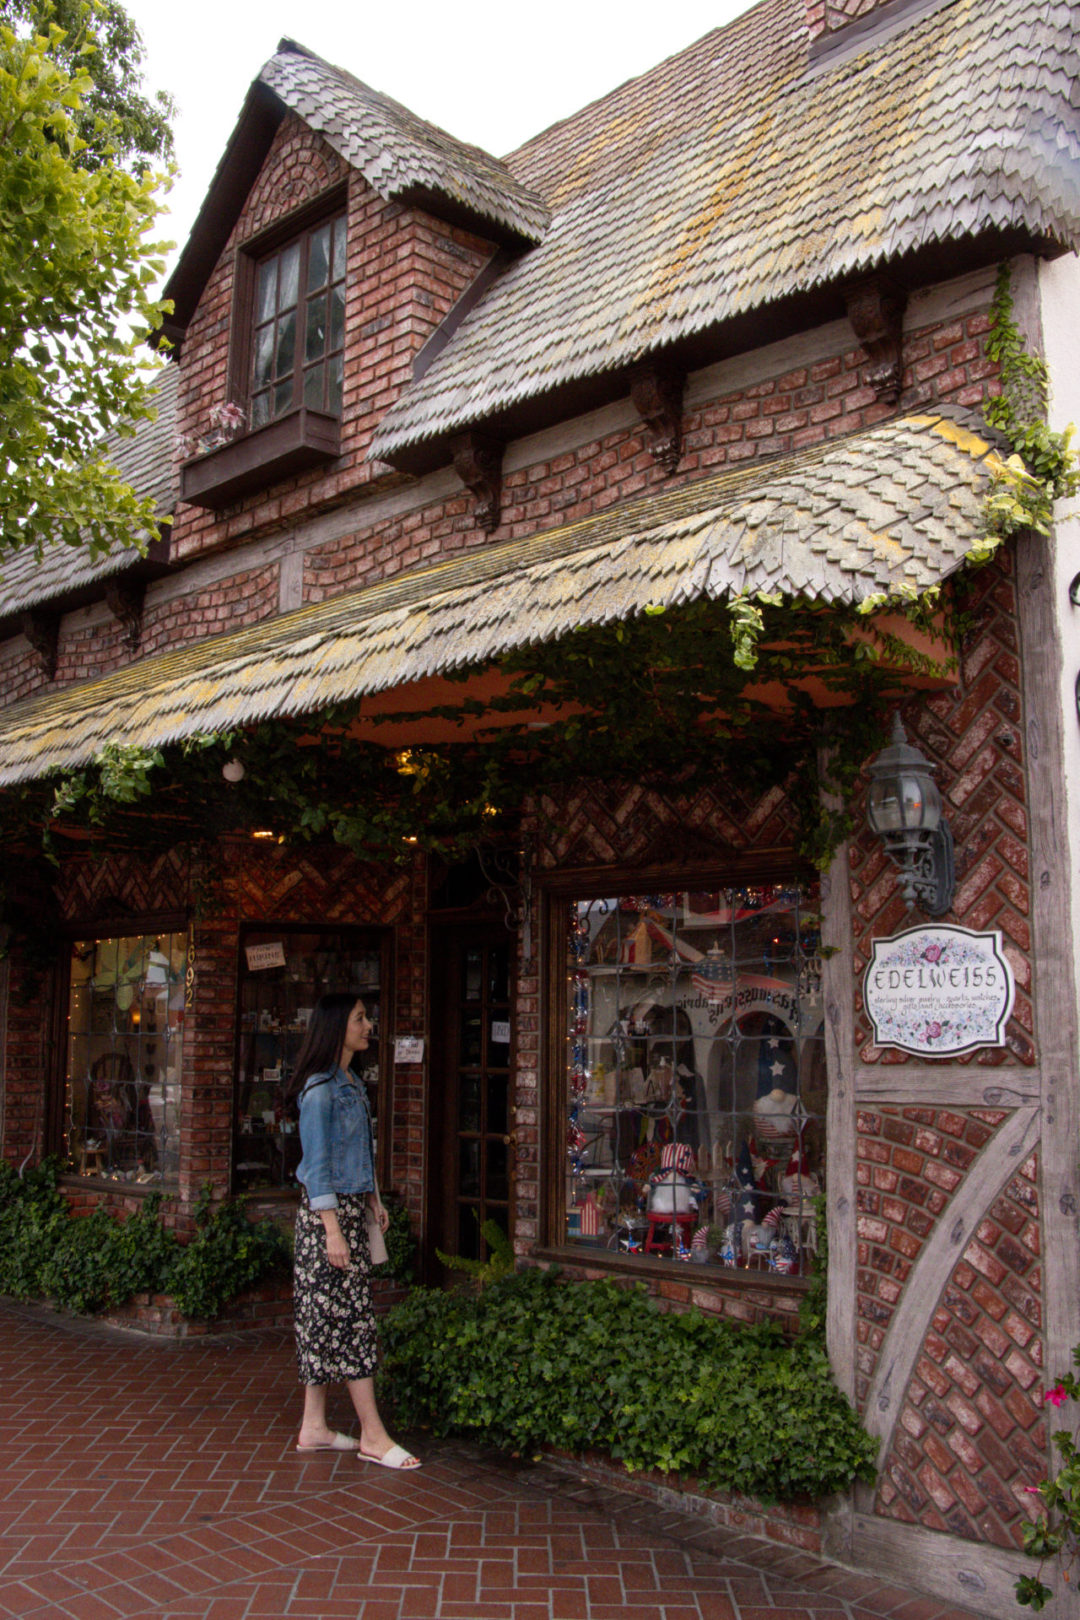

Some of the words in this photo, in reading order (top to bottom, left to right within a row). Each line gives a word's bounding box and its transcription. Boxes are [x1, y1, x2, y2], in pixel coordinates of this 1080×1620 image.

[185, 922, 196, 1008] 1692
[874, 966, 997, 990] EDELWEISS
[874, 993, 898, 1011] sterling
